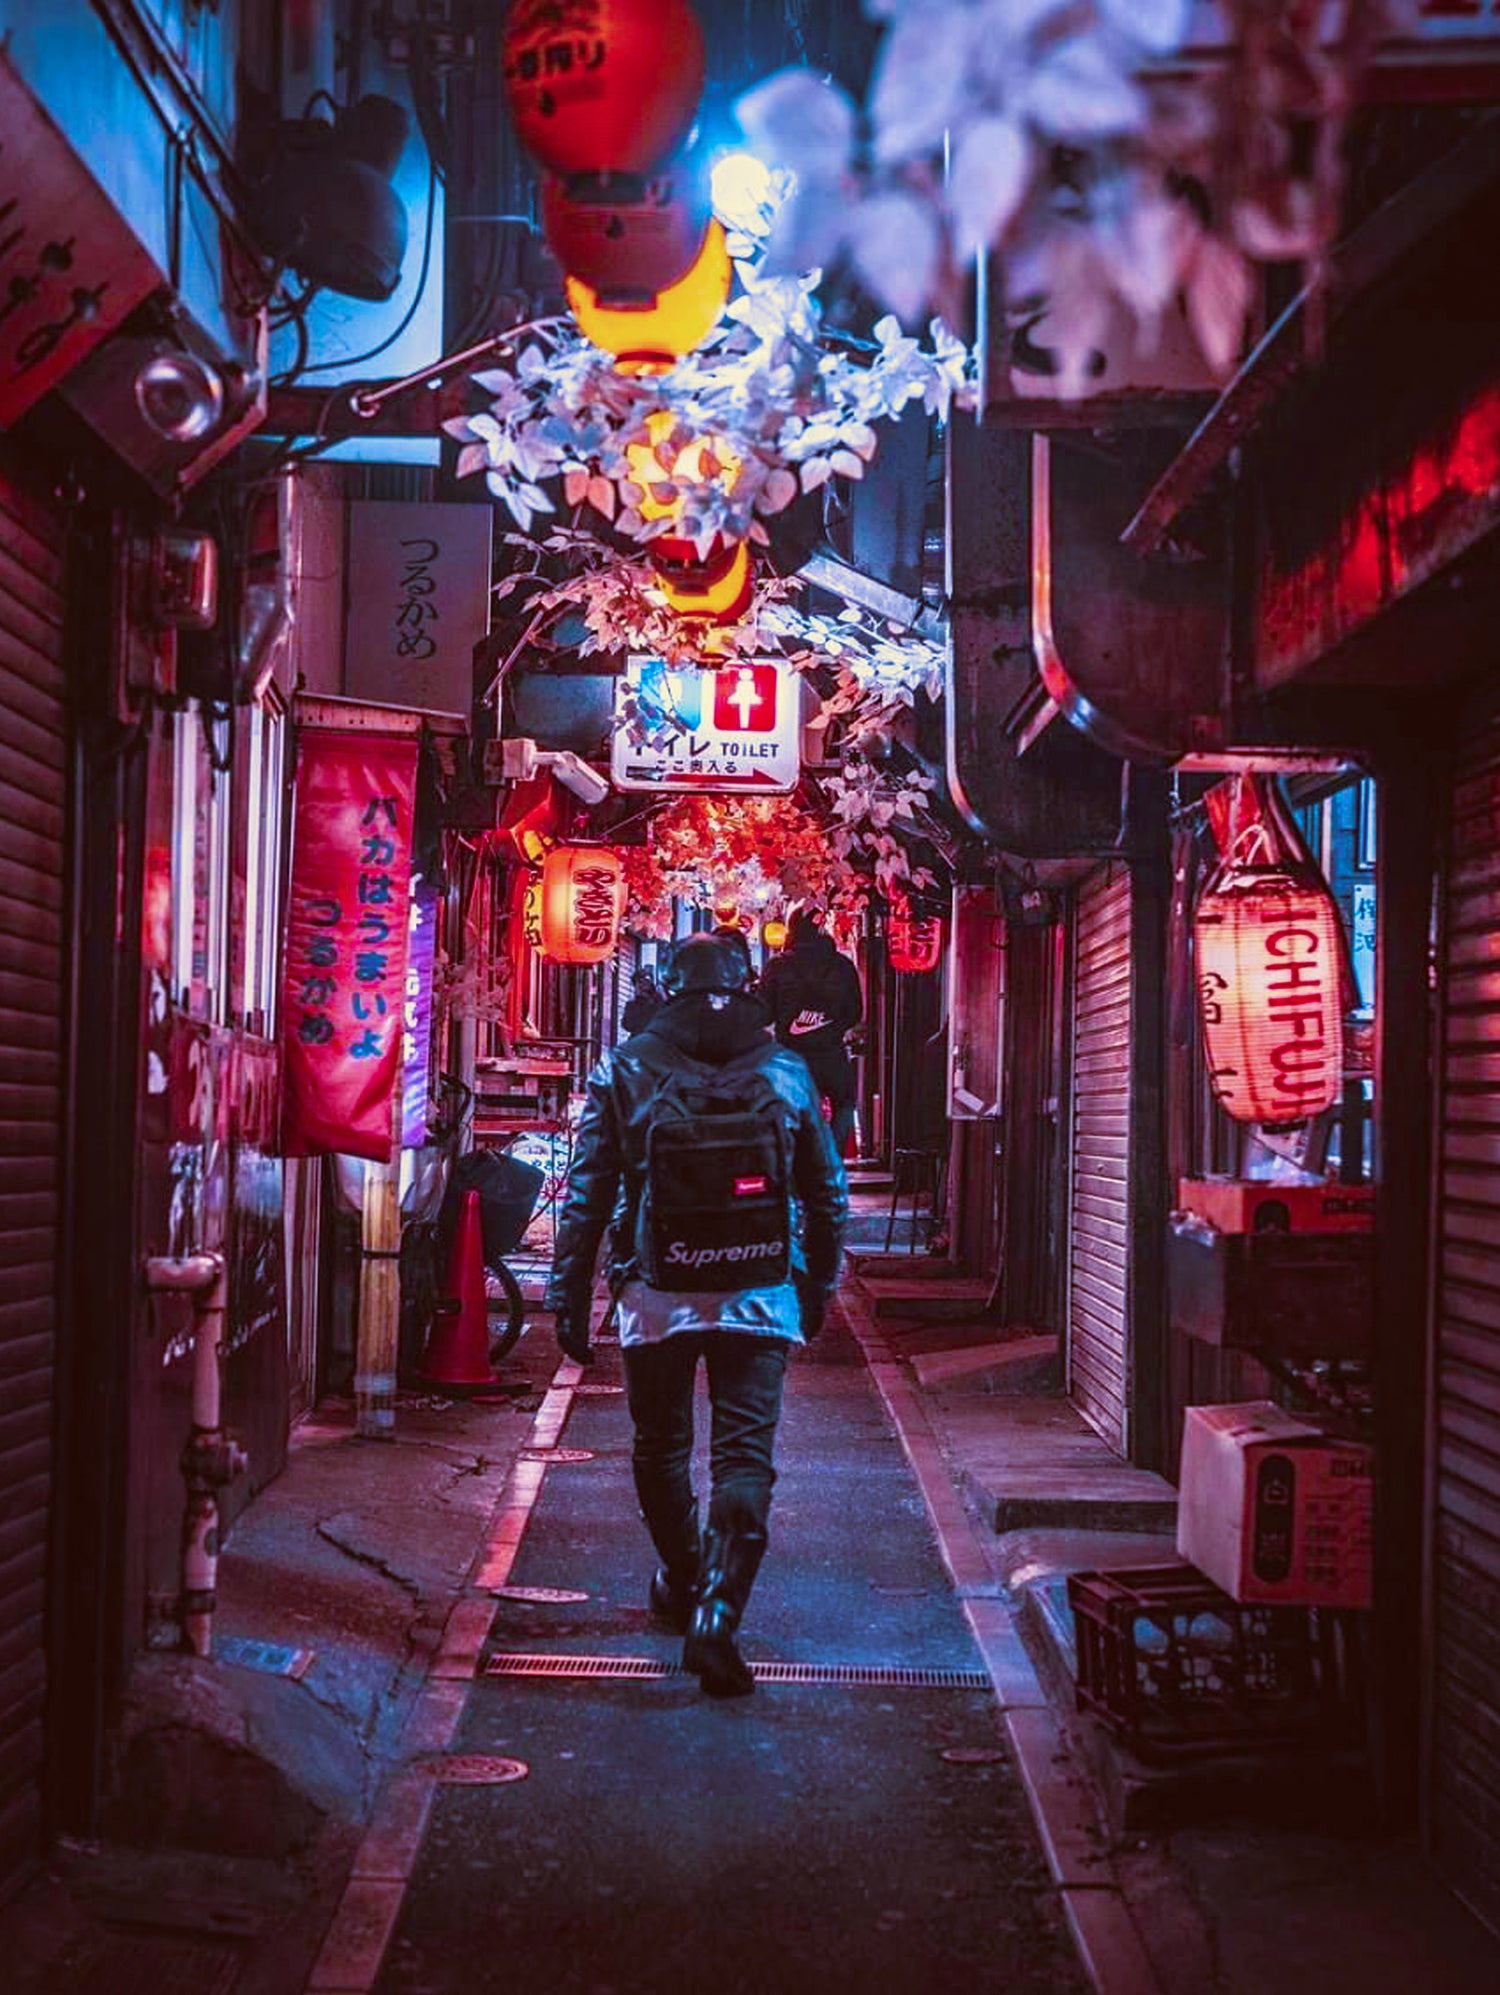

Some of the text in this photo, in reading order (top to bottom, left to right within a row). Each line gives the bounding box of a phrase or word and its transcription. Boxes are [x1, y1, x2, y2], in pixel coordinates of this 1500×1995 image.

[396, 539, 440, 660] つるかめ
[720, 742, 780, 758] TOILET
[299, 898, 342, 1045] つるかめ
[797, 1009, 826, 1026] NIKE
[1260, 909, 1327, 1111] ICHIFUJI
[664, 1240, 783, 1268] Supreme
